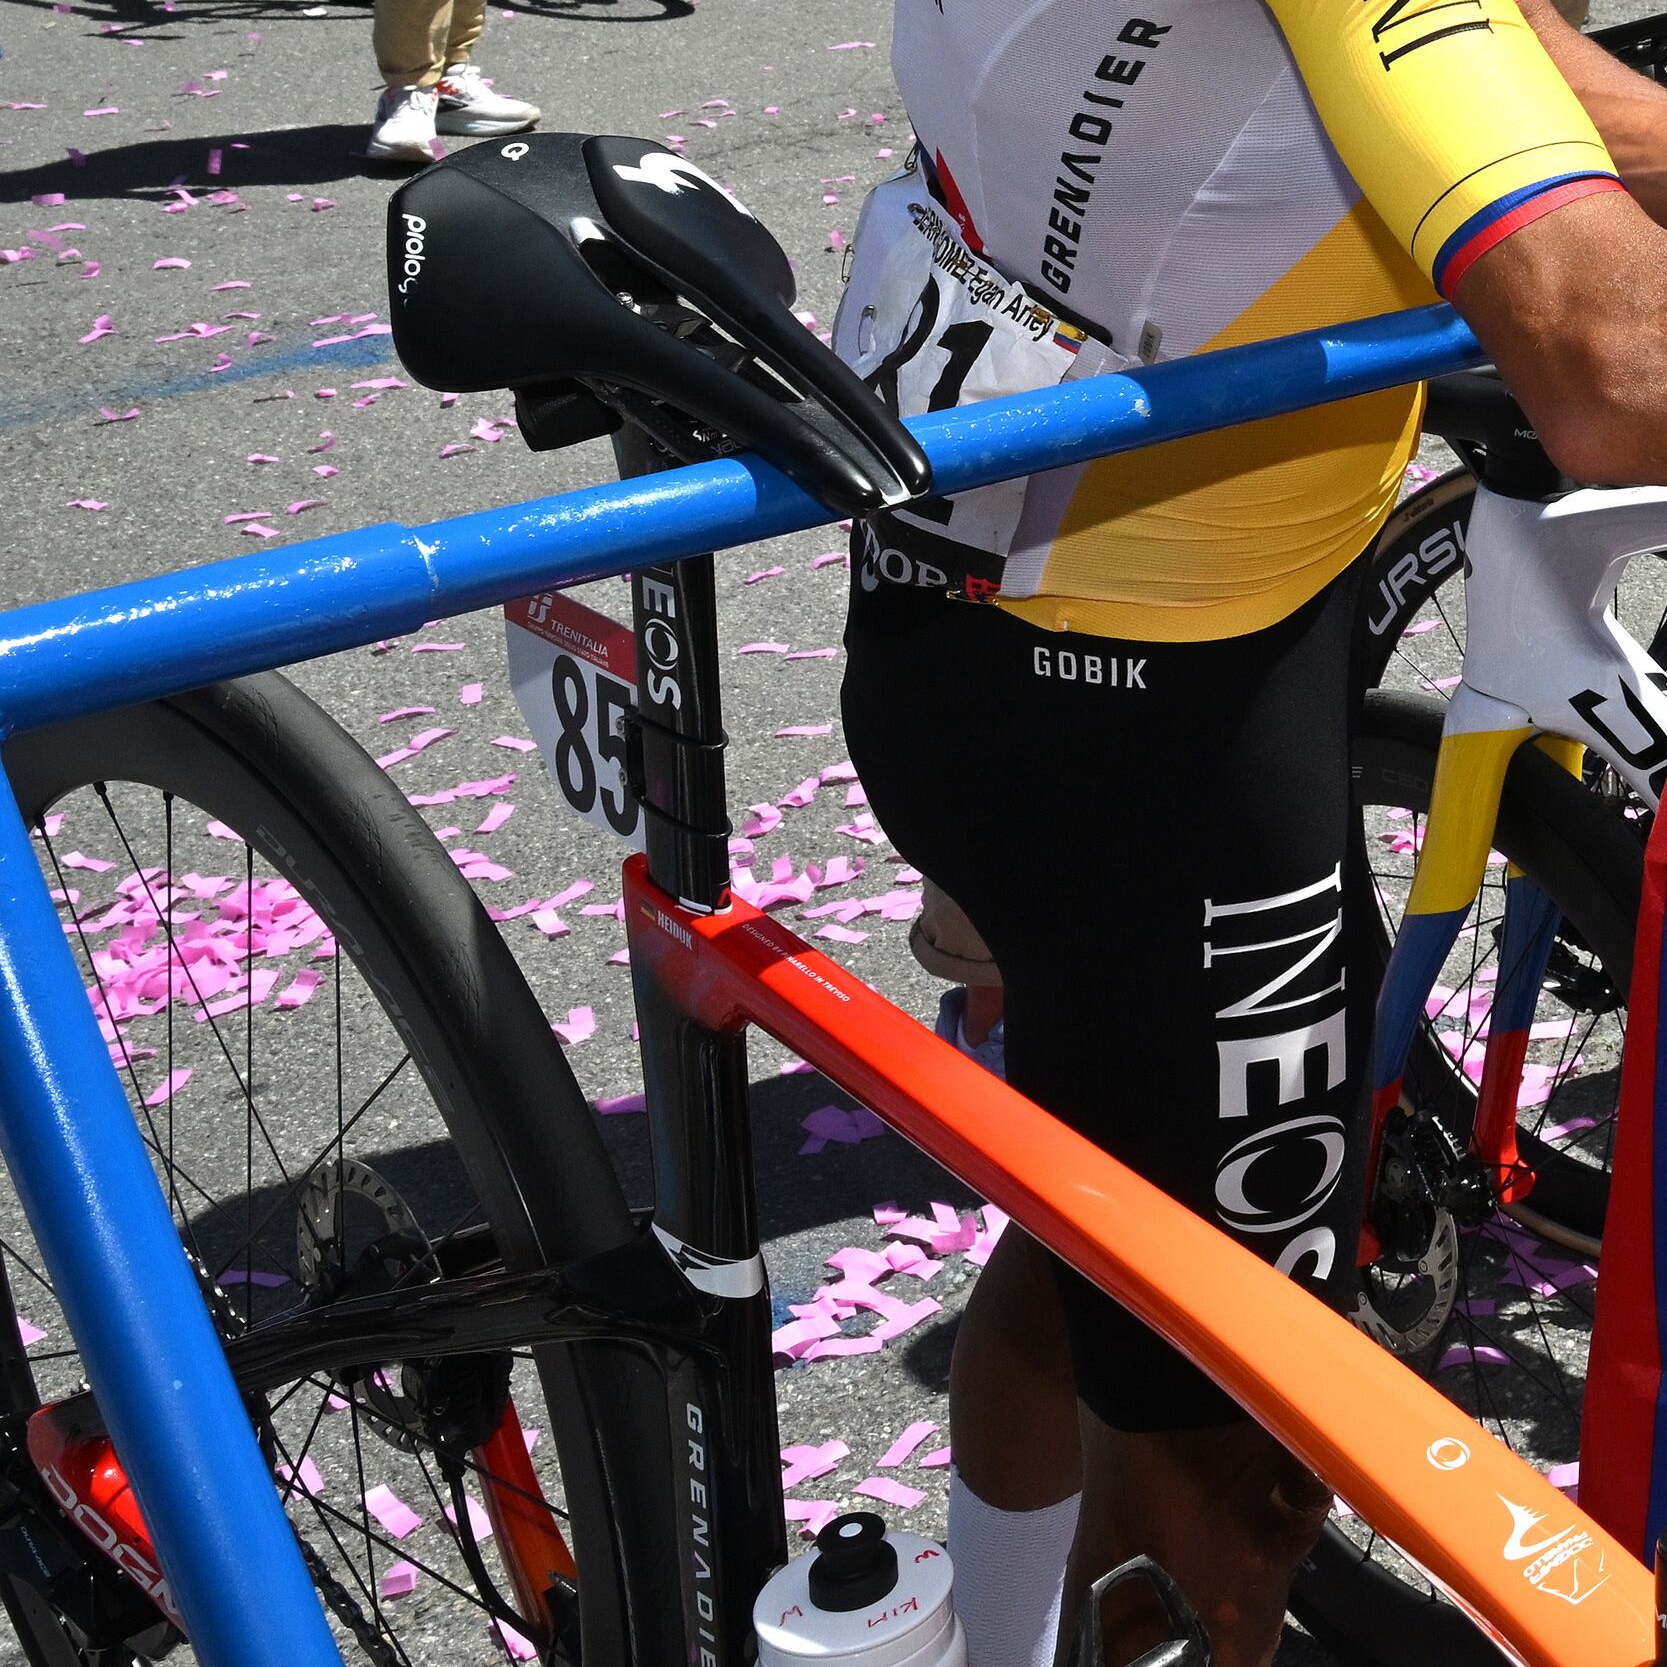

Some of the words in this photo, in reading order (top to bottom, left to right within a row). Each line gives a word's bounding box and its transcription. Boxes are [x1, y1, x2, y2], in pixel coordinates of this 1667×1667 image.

[1041, 17, 1173, 293] GRENADIER
[550, 617, 609, 660] TRENITALIA
[1033, 645, 1148, 690] GOBIK
[550, 653, 641, 837] 85
[656, 909, 694, 952] HEIDUK
[742, 922, 775, 951] DESIGNED
[780, 949, 817, 980] PINARELLO
[821, 978, 852, 1003] TREVISO
[1202, 859, 1349, 1282] INEOS
[684, 1402, 715, 1667] GRENADIE
